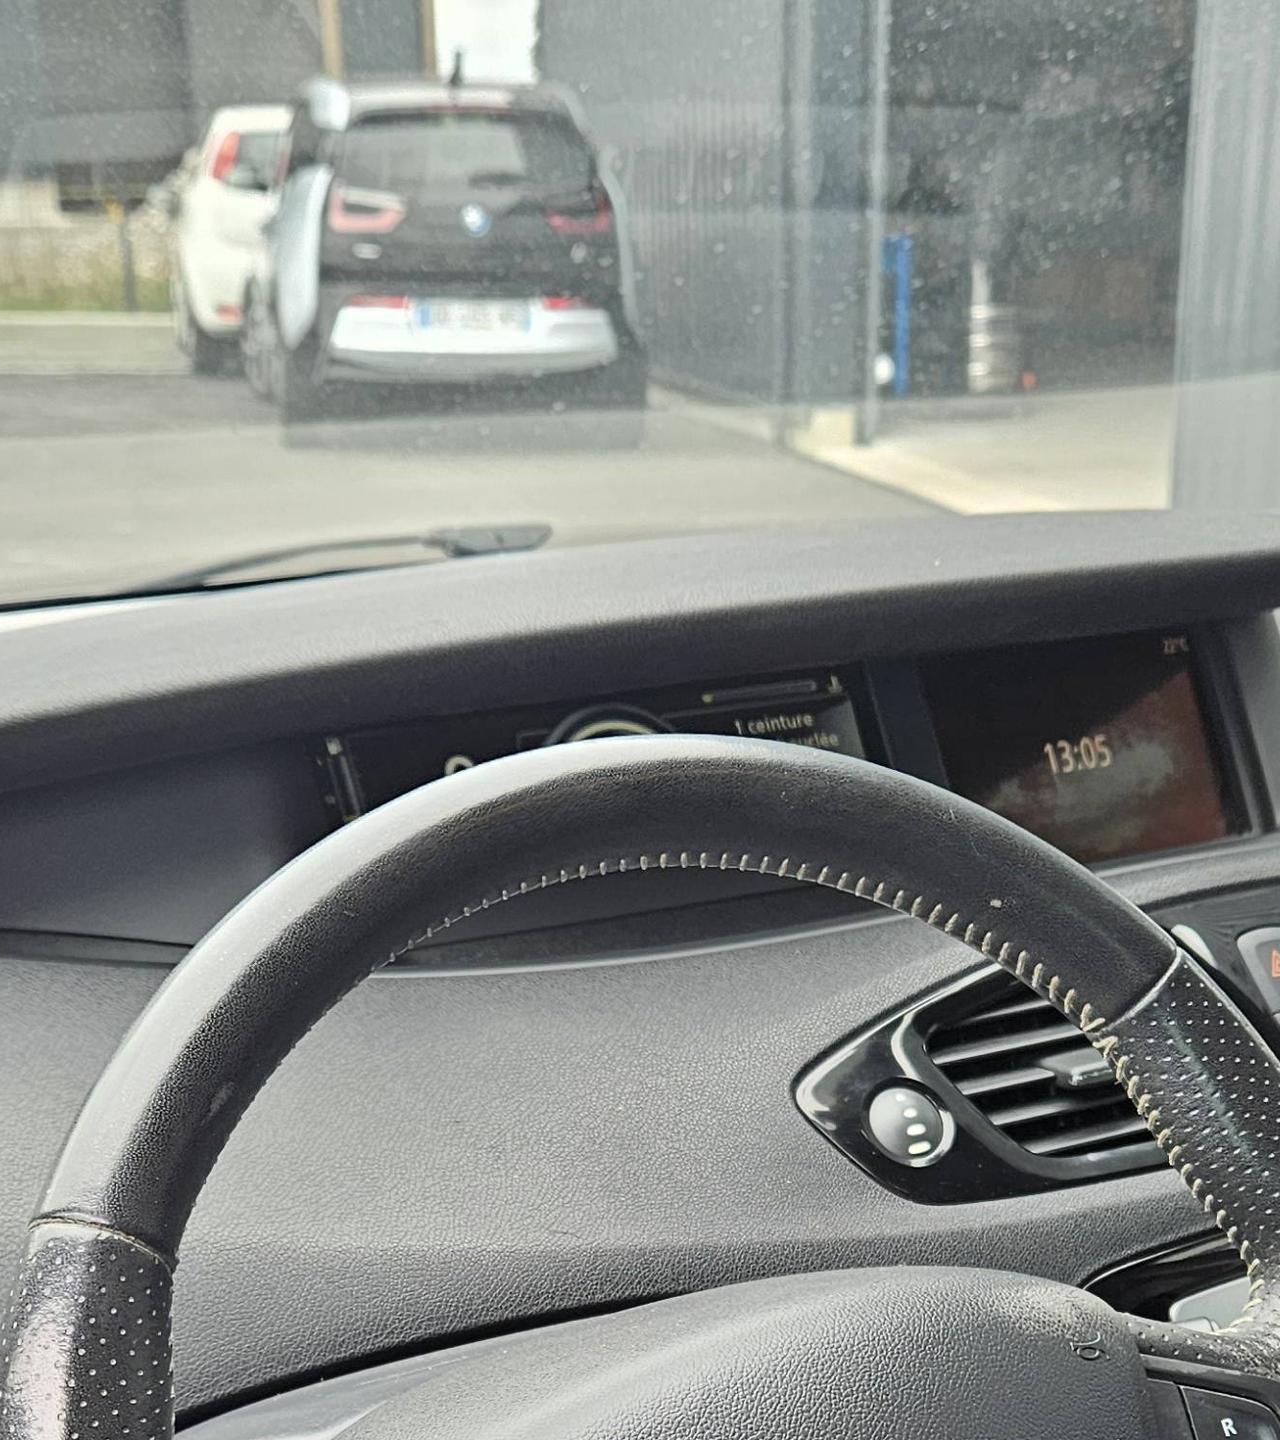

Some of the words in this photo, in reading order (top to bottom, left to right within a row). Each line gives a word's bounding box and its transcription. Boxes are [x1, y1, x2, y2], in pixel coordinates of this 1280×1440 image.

[747, 713, 814, 735] ceinture
[1043, 733, 1113, 775] 13:05
[1220, 1417, 1237, 1437] R
